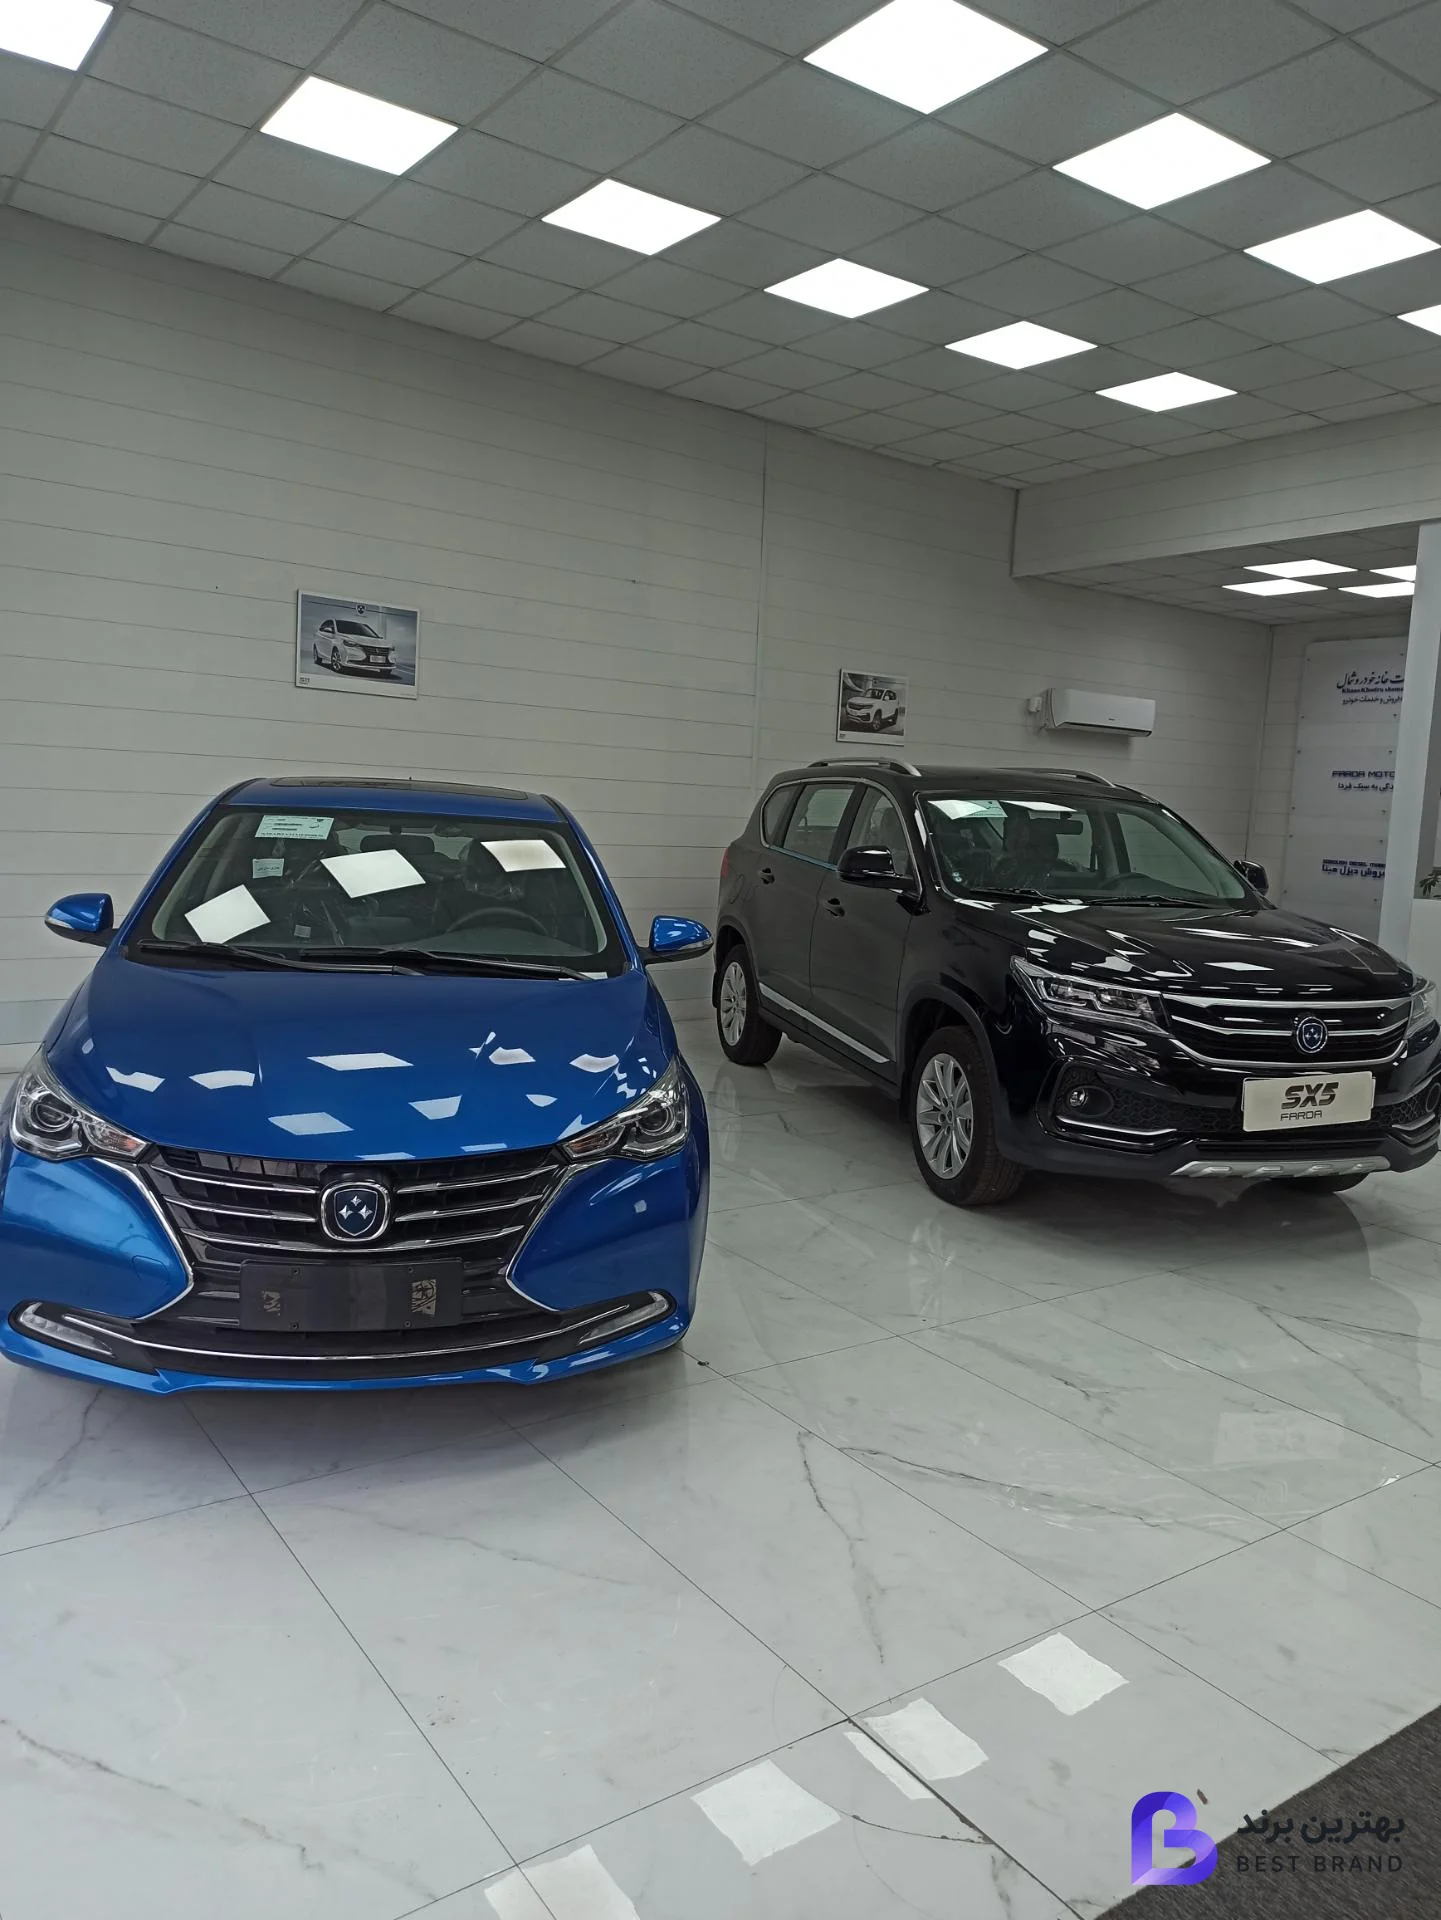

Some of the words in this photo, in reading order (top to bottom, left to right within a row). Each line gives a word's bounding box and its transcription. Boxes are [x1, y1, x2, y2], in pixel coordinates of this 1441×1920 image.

[1368, 770, 1395, 778] MOTO
[1281, 1082, 1339, 1109] SX5
[1280, 1110, 1322, 1121] FARDA
